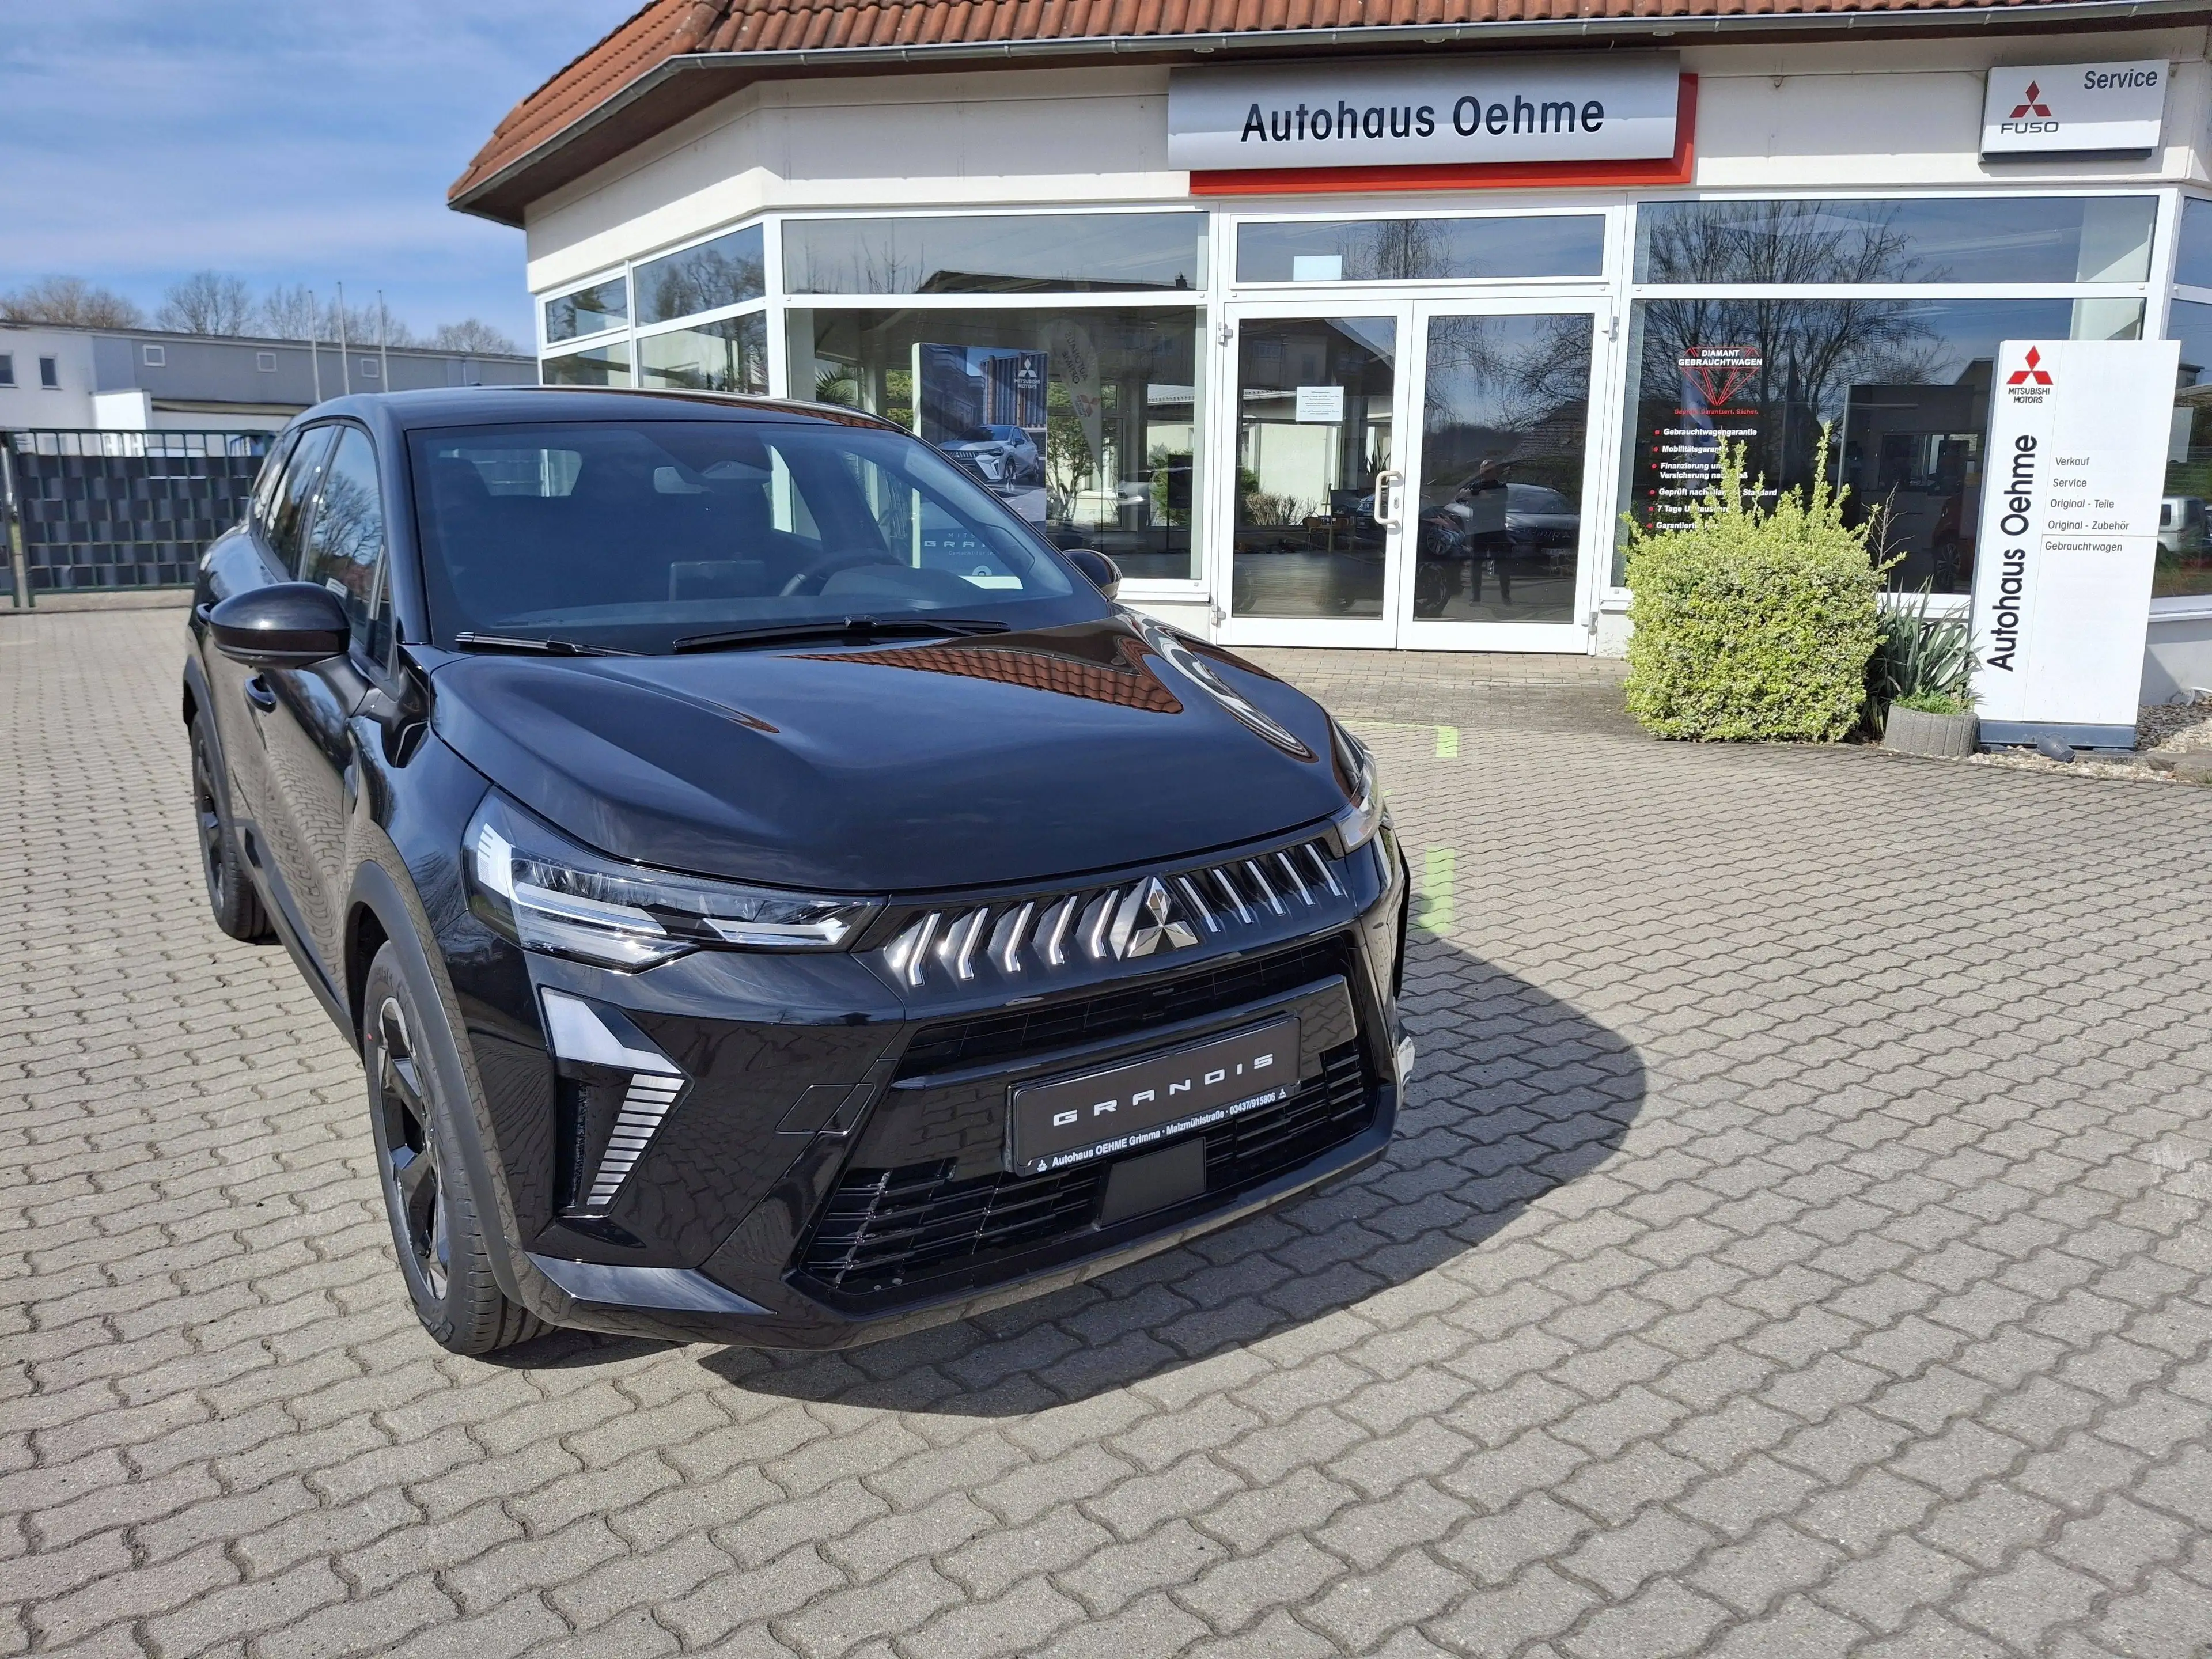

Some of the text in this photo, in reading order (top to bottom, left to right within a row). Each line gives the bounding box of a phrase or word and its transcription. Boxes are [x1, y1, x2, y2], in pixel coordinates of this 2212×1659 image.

[2084, 68, 2158, 90] Service
[1240, 94, 1604, 142] Autohaus Oehme
[2000, 121, 2059, 134] FUSO
[2008, 387, 2051, 395] MITSUBISHI
[2013, 396, 2043, 404] MOTORS
[1663, 428, 1758, 437] Gebrauchtwagengarantie
[1661, 462, 1709, 471] Finanzierung
[2055, 457, 2090, 466] Verkauf
[1660, 471, 1710, 480] Versicherung
[2052, 478, 2088, 487] Service
[1658, 488, 1688, 497] Geprüft
[1664, 505, 1683, 513] Tage
[2050, 499, 2085, 510] Original
[2094, 499, 2115, 509] Teile
[2048, 520, 2083, 531] Original
[2092, 521, 2130, 530] Zubehör
[2045, 541, 2123, 553] Gebrauchtwagen
[1986, 434, 2037, 672] Autohaus Oehme
[1053, 1053, 1274, 1127] GRANDIS
[1052, 1092, 1275, 1168] Autohaus OEHME Grimma Malzmühlstraße 03437/915806
